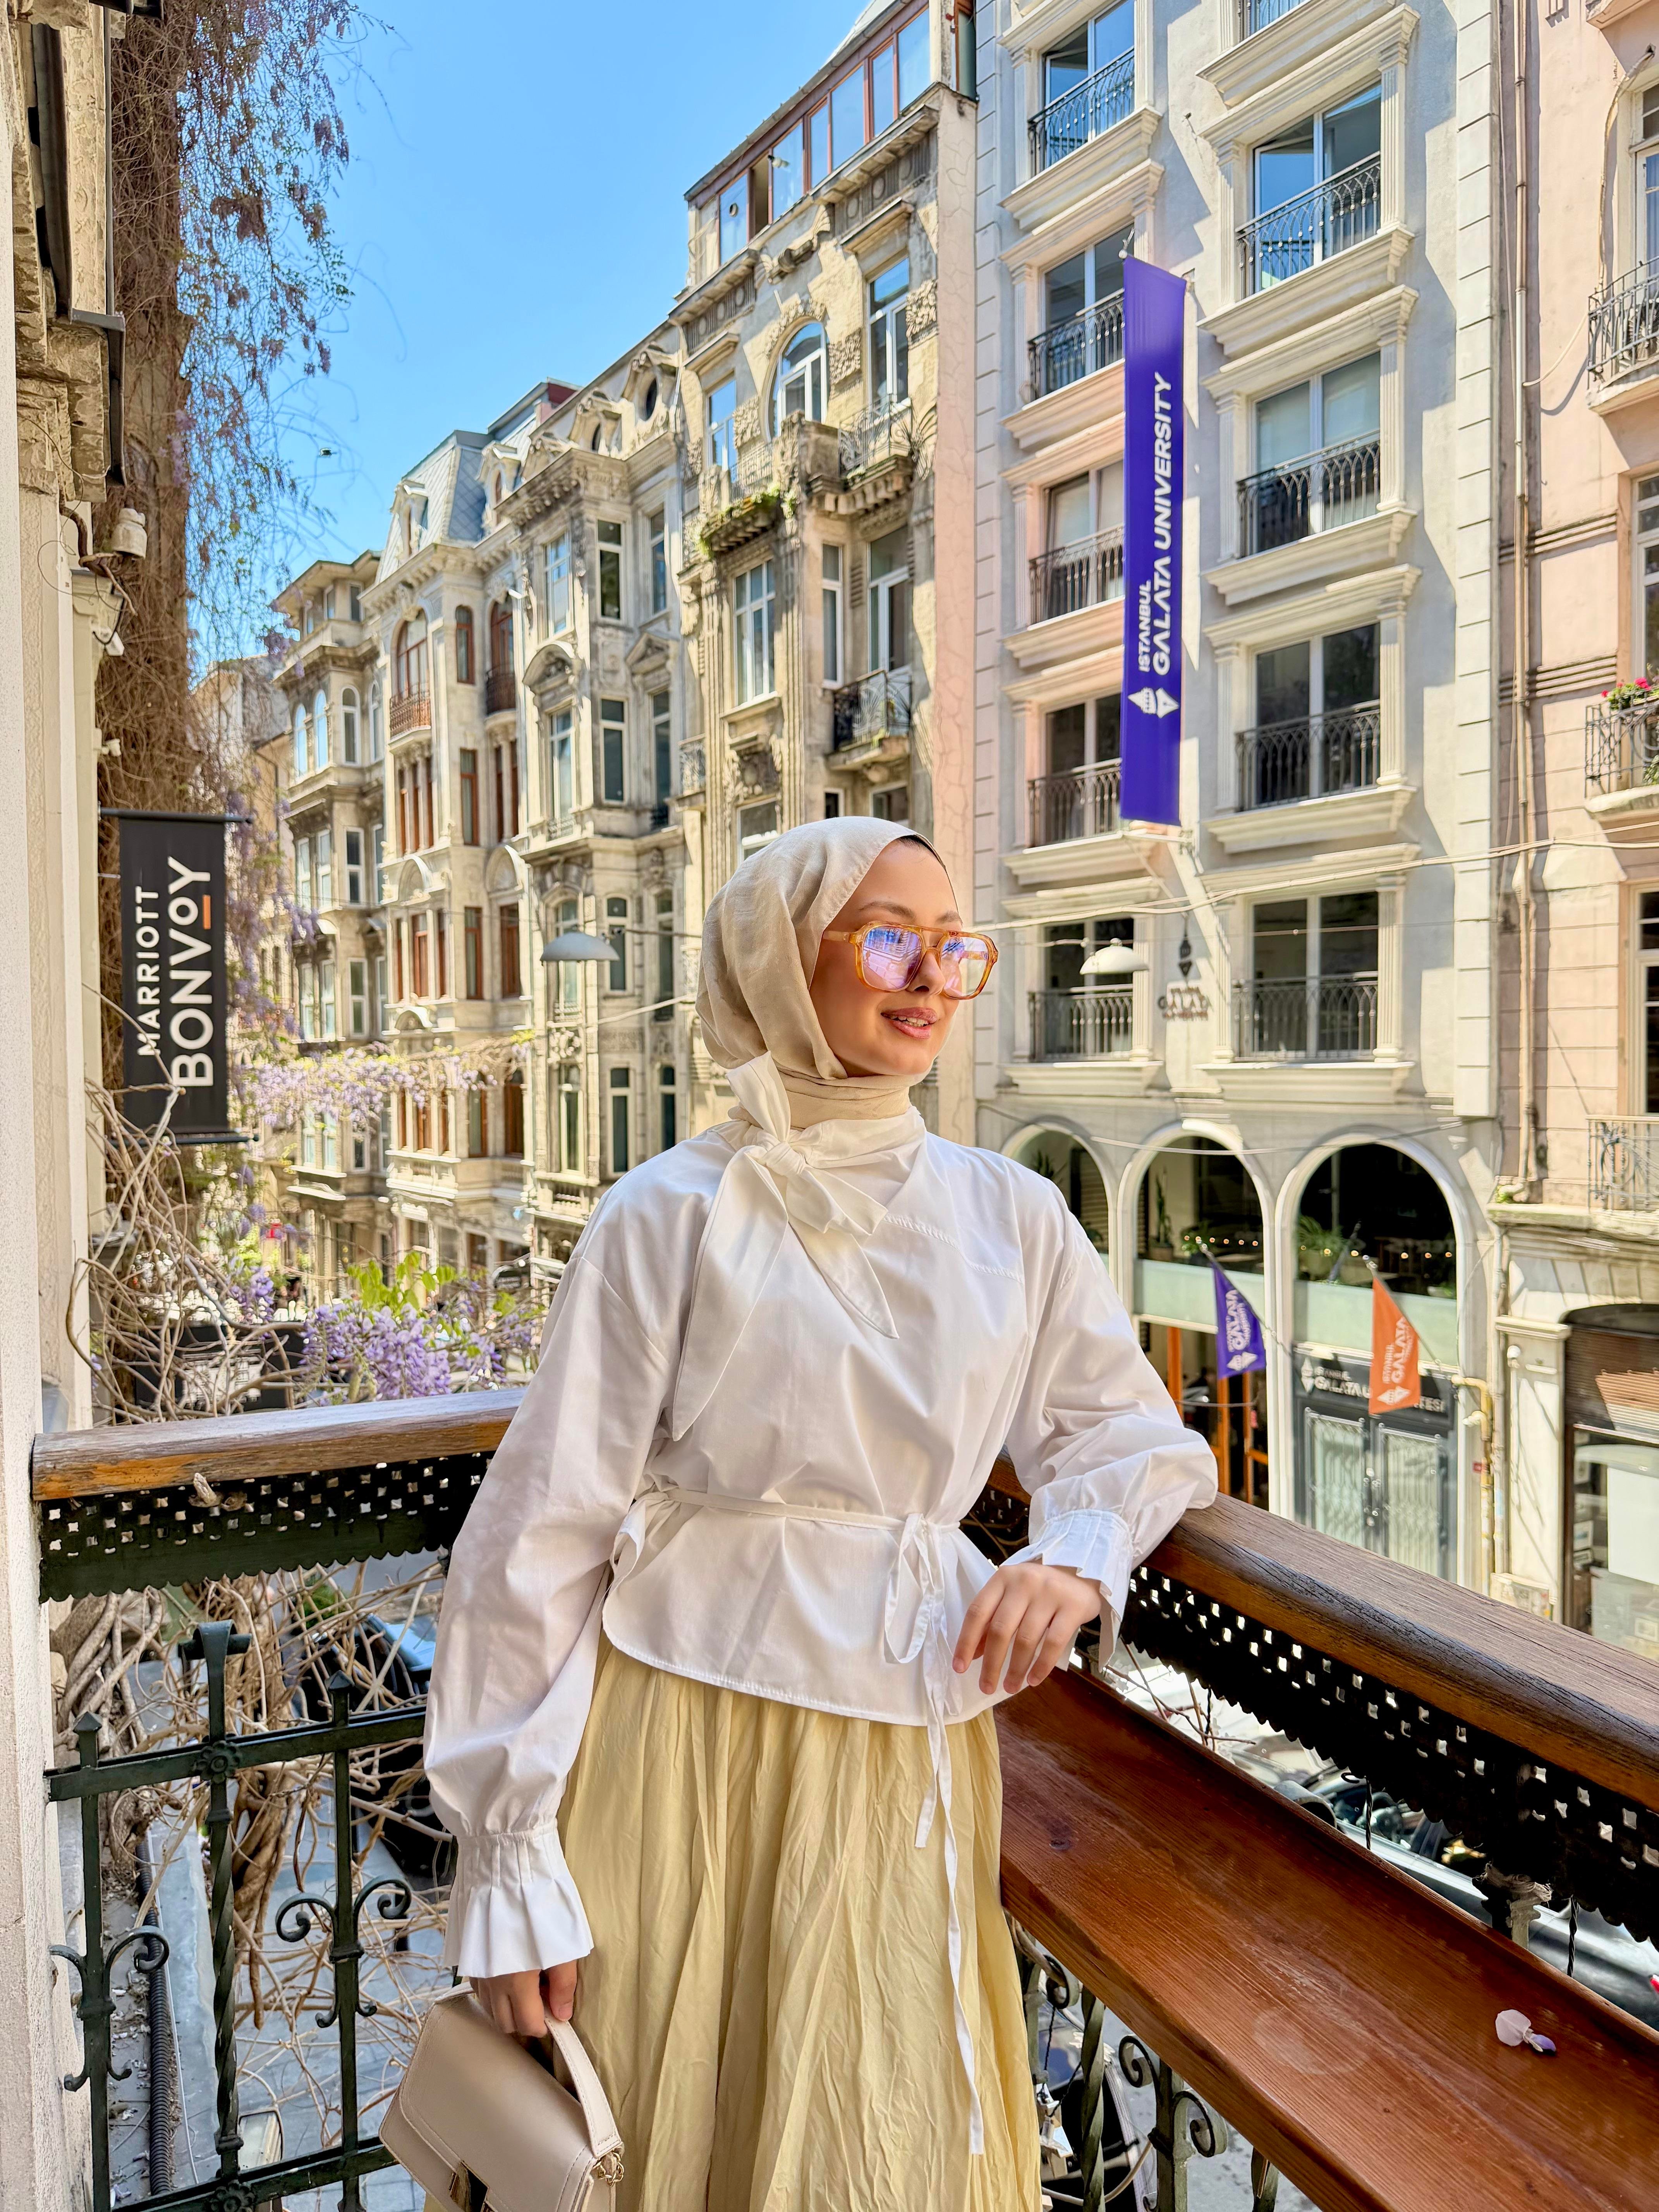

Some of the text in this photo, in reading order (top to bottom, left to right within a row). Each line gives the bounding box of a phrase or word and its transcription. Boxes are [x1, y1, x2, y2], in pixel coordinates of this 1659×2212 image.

[1152, 371, 1172, 675] GALATA UNIVERSITY
[1138, 579, 1151, 672] ISTANBUL
[135, 886, 160, 1056] MARRIOTT
[168, 856, 214, 1087] BONVOY
